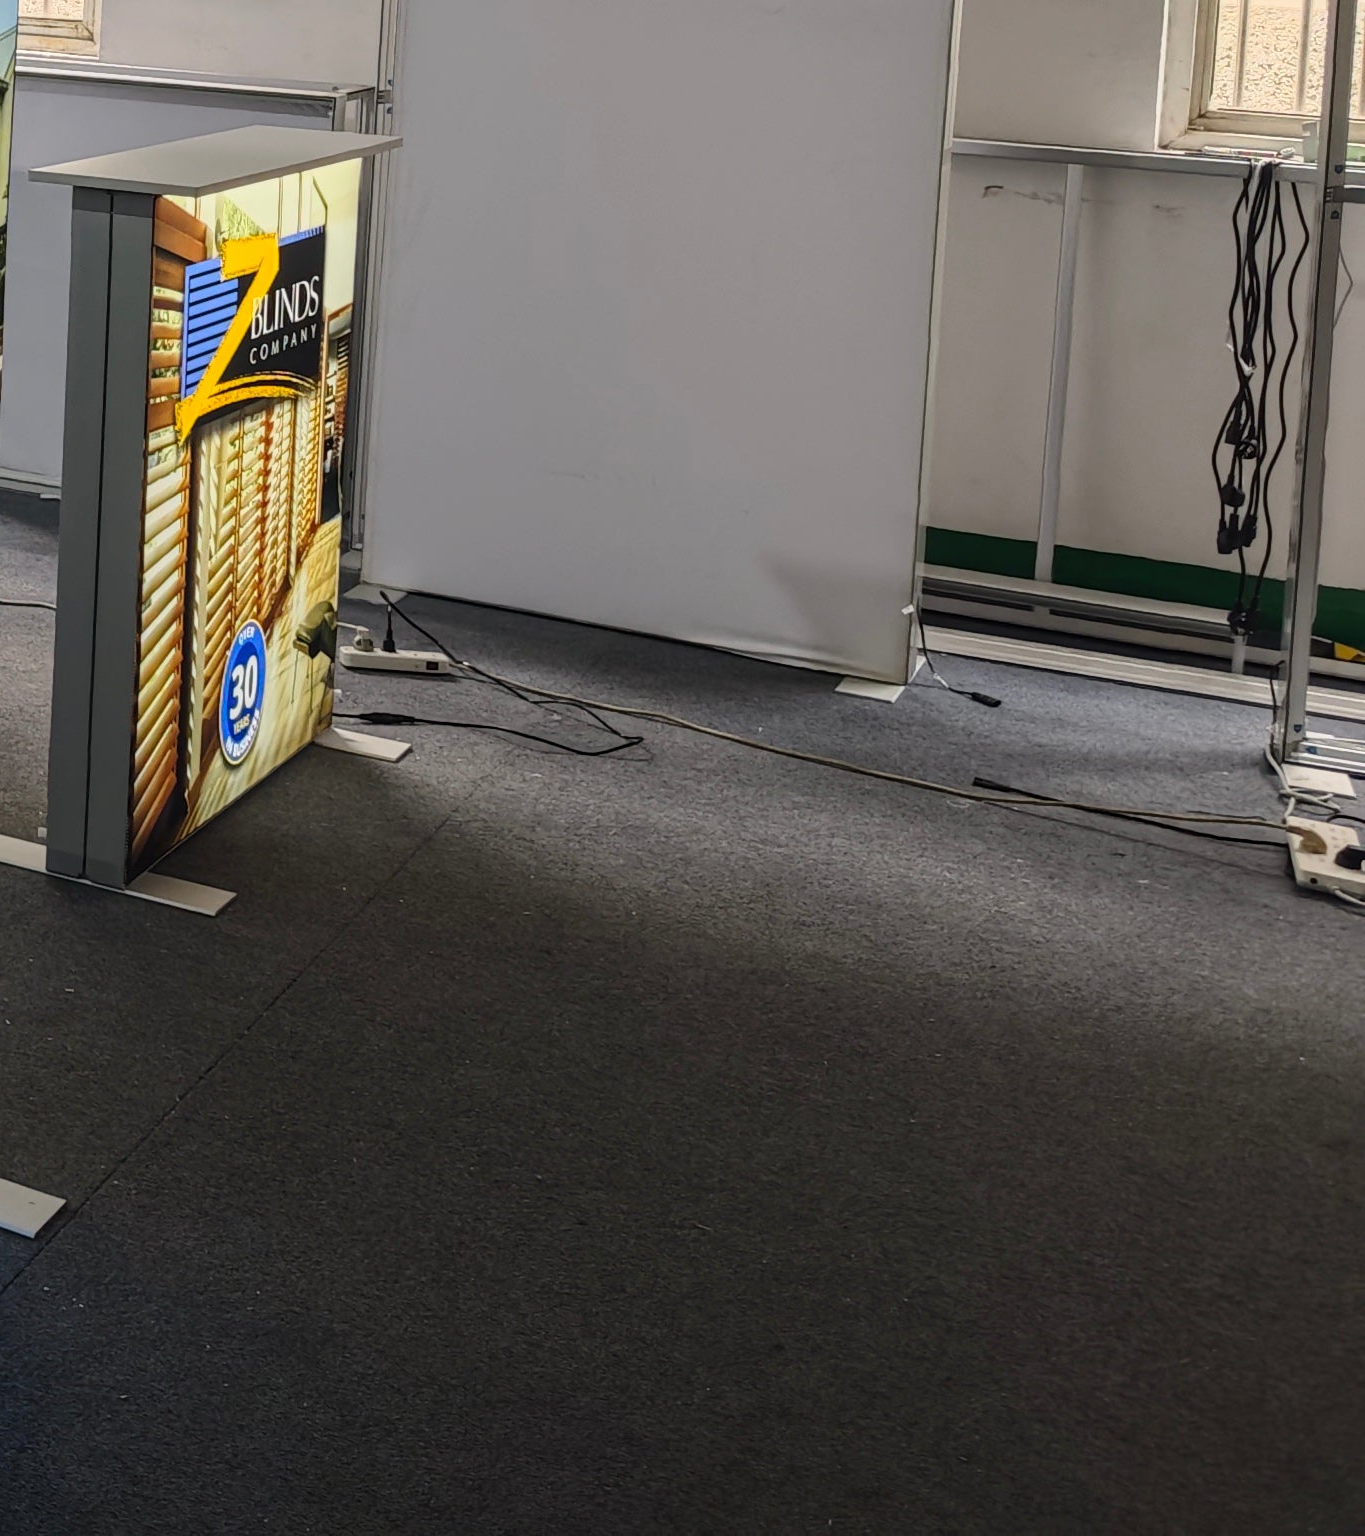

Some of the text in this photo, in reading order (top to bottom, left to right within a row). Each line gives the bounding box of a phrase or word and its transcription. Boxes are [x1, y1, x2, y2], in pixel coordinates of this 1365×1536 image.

[250, 276, 319, 340] BLINDS
[249, 323, 317, 365] COMPANY
[229, 655, 258, 721] 30
